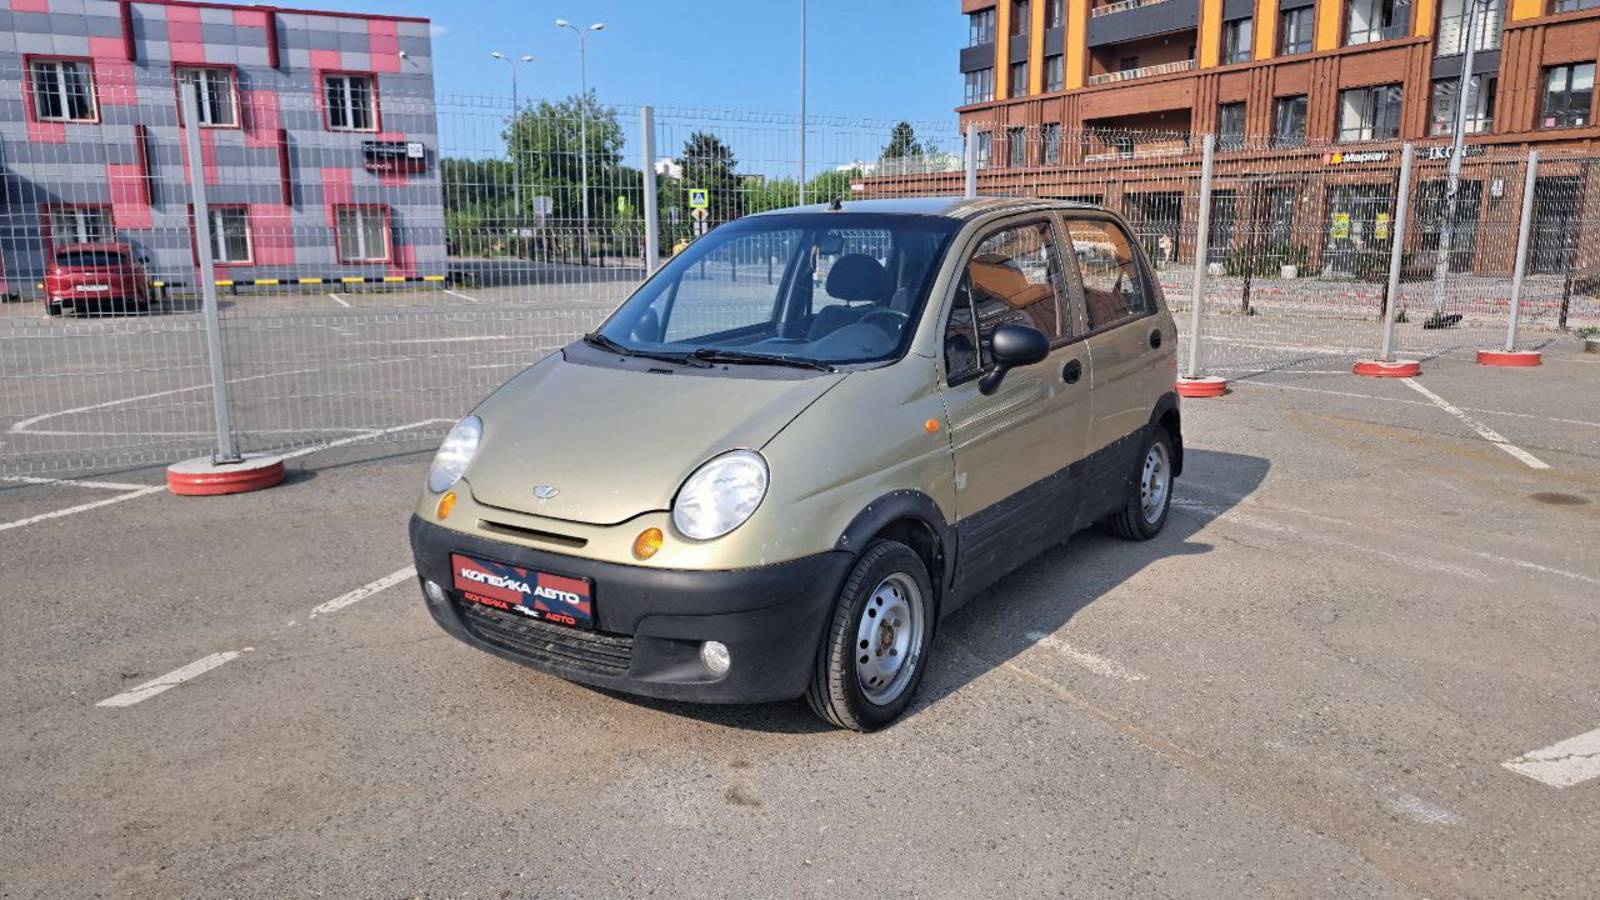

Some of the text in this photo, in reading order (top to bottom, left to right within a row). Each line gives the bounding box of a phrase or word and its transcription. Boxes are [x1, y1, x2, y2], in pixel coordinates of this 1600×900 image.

[1343, 152, 1388, 163] Маркет
[461, 568, 580, 605] КОПЕЙКА АВТО
[464, 592, 576, 625] КОПЕЙКА АВТО
